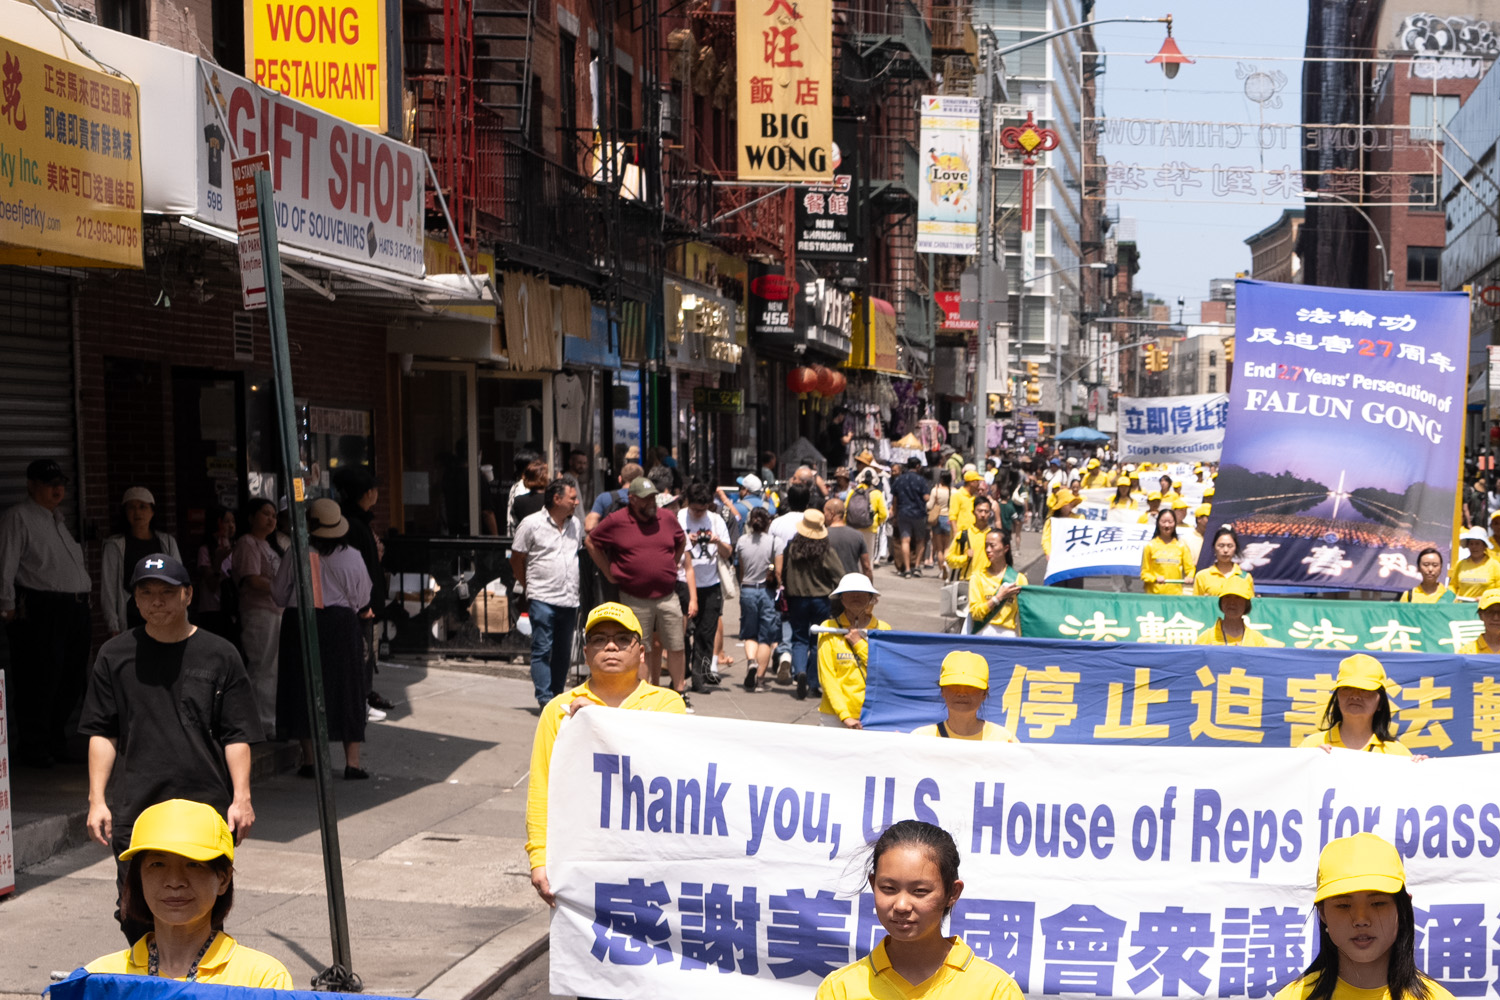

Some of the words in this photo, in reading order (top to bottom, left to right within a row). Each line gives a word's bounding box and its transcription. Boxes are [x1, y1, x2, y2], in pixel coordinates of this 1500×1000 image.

[267, 4, 359, 45] WONG
[44, 64, 132, 119] 正宗馬來西亞風味
[255, 59, 377, 100] RESTAURANT
[750, 76, 819, 106] 飯店
[761, 113, 808, 139] BIG
[19, 147, 41, 185] Inc.
[229, 86, 318, 200] GIFT
[328, 125, 413, 227] SHOP
[745, 145, 826, 172] WONG
[932, 168, 969, 182] Love
[206, 190, 222, 212] 59B
[804, 193, 849, 215] 餐館
[76, 216, 138, 248] 212-965-0796
[292, 205, 305, 232] OF
[309, 208, 365, 250] SOUVENIRS
[815, 219, 834, 229] NEW
[379, 237, 394, 256] HATS
[400, 244, 412, 261] FOR
[798, 241, 854, 252] RESTAURANT
[762, 312, 789, 325] 456
[768, 302, 783, 311] NEW
[1296, 308, 1416, 332] 法輪功
[945, 321, 978, 329] PHARMAC
[1246, 327, 1456, 373] 反迫害27周年
[1244, 362, 1276, 379] End
[1278, 364, 1303, 381] 27
[1304, 367, 1349, 387] Years'
[1353, 374, 1436, 406] Persecution
[1438, 396, 1453, 413] of
[1244, 389, 1353, 420] FALUN
[1361, 402, 1443, 445] GONG
[1127, 445, 1150, 455] Stop
[1153, 443, 1216, 455] Persecution
[593, 752, 732, 837] Thank
[746, 784, 842, 861] you,
[970, 781, 1116, 860] House
[1132, 786, 1177, 862] of
[1191, 788, 1303, 879] Reps
[1319, 788, 1381, 836] for
